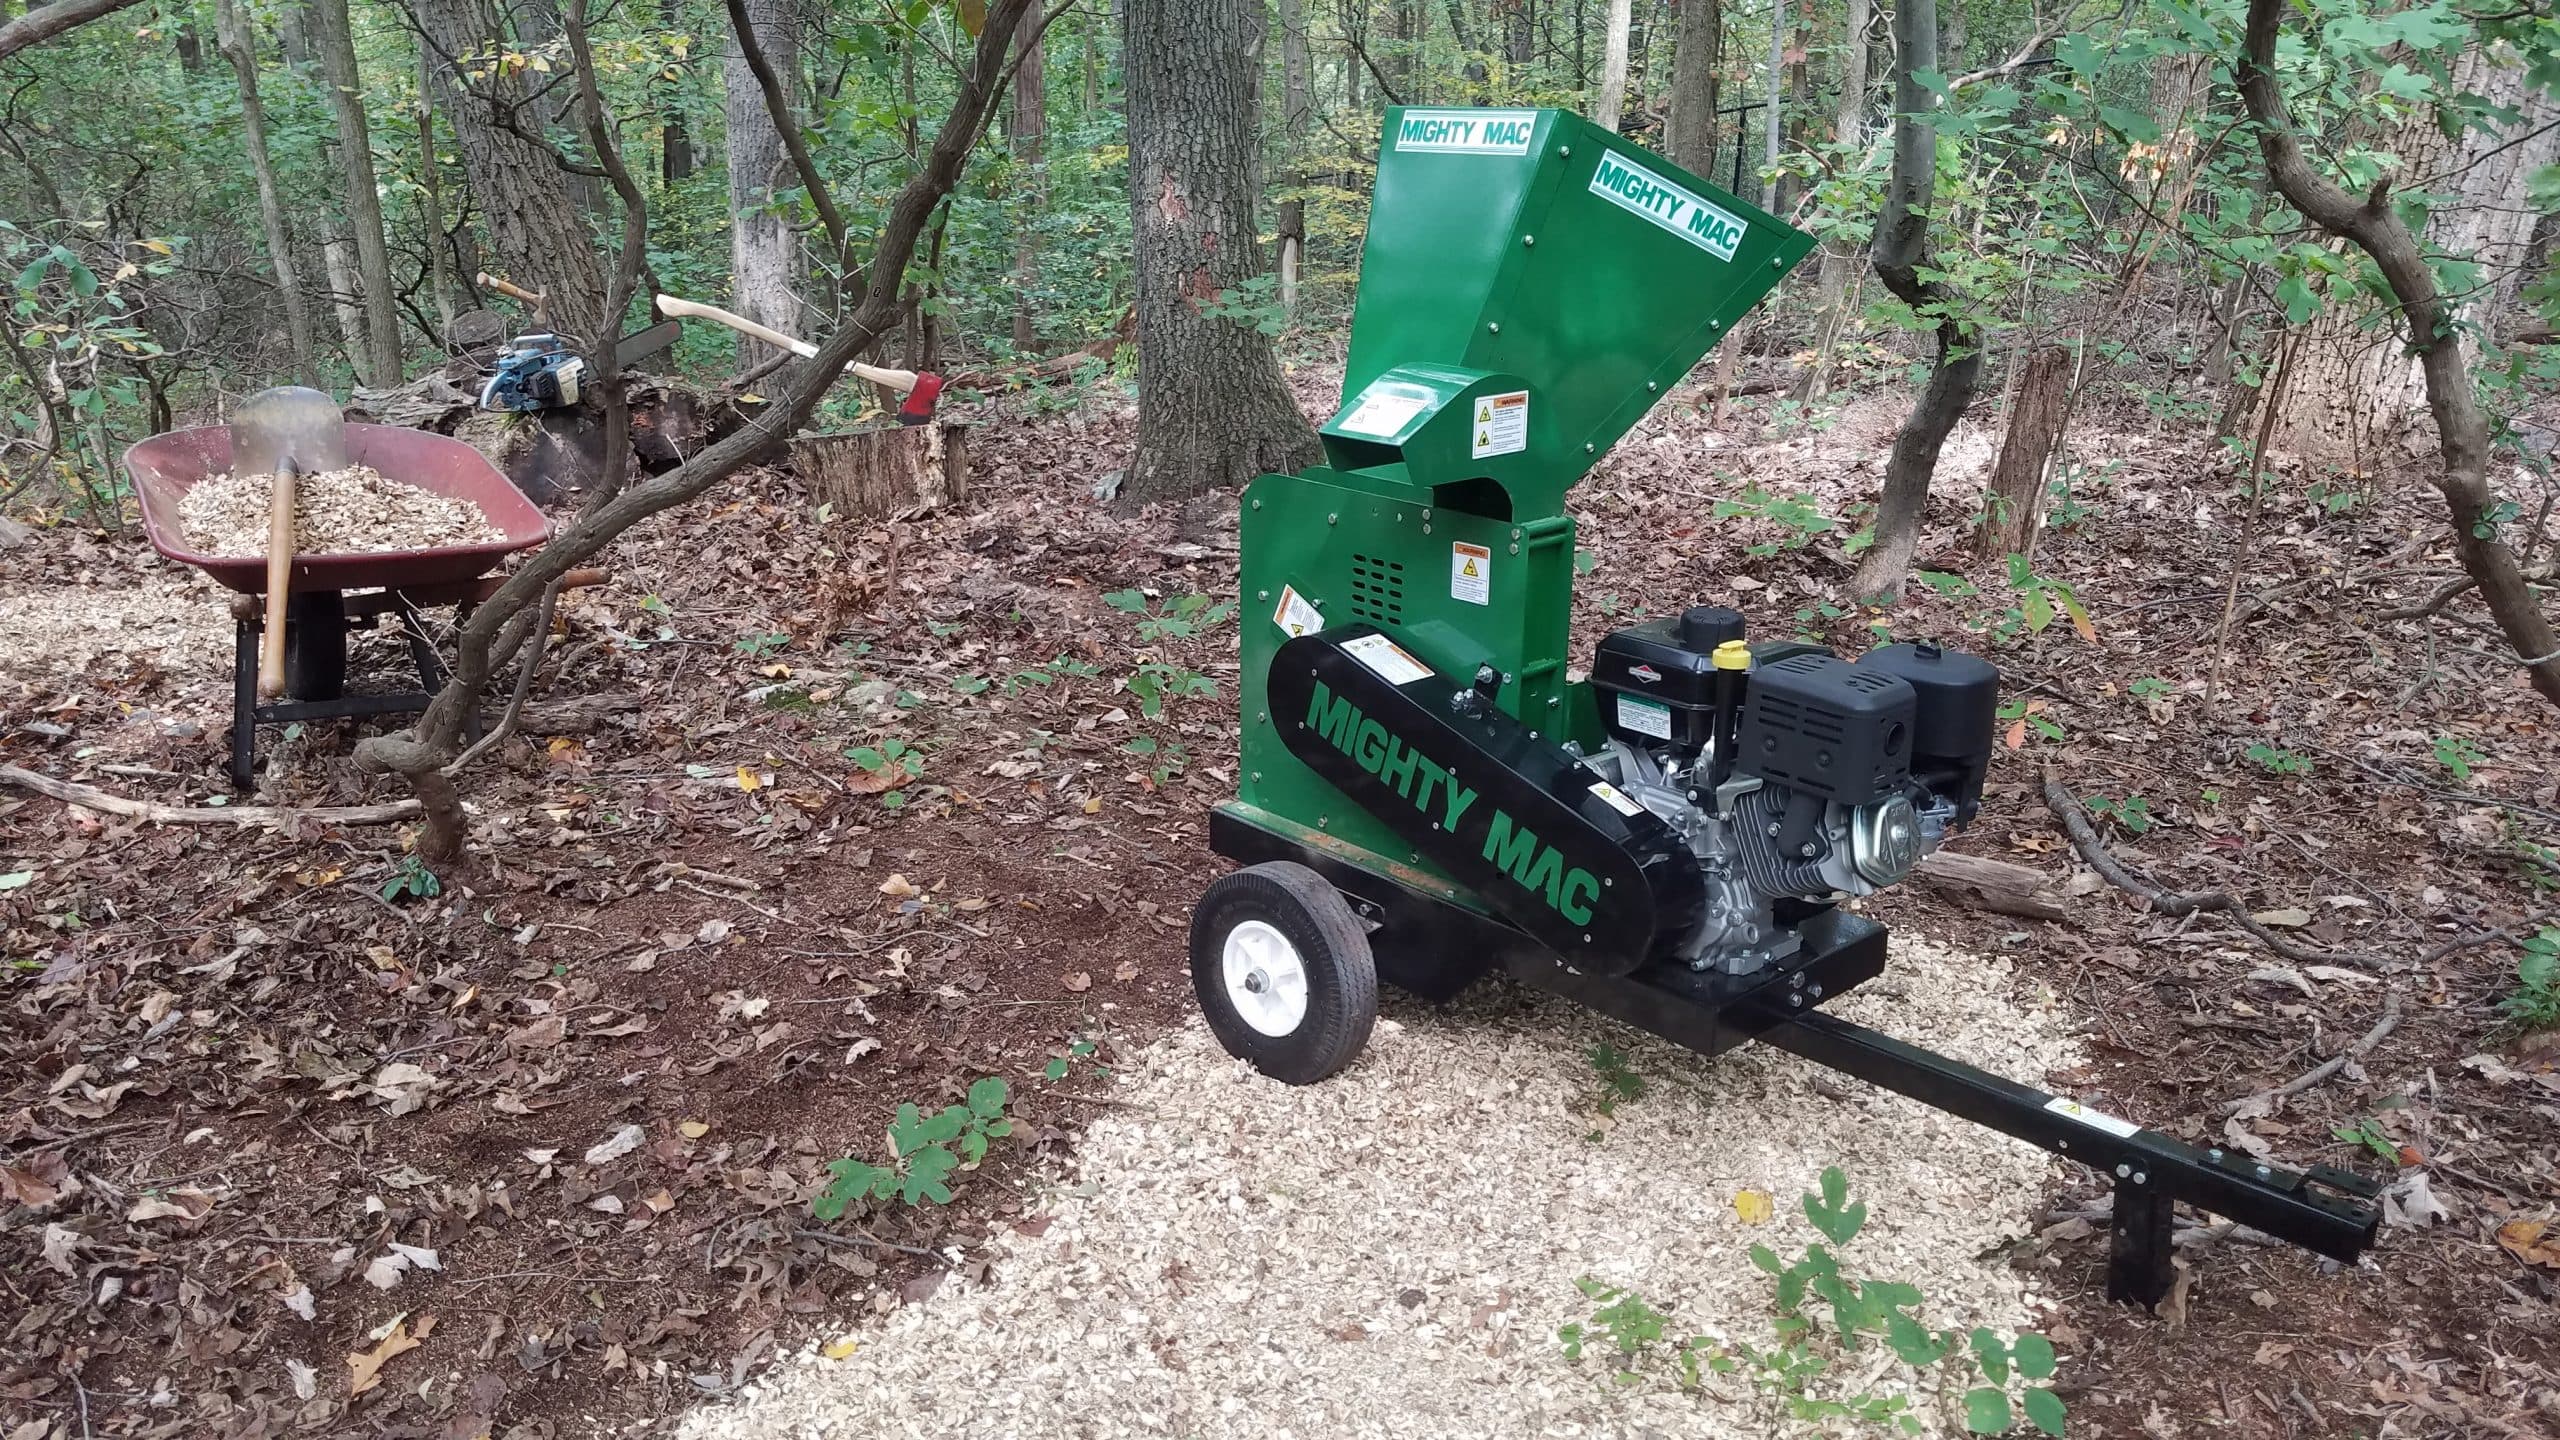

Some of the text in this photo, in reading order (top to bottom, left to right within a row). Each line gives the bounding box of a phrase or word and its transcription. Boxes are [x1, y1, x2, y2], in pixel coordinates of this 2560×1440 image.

[1400, 119, 1531, 145] MIGHTY MAC
[1595, 159, 1740, 251] MIGHTY MAC
[1306, 679, 1600, 926] MIGHTY MAC
